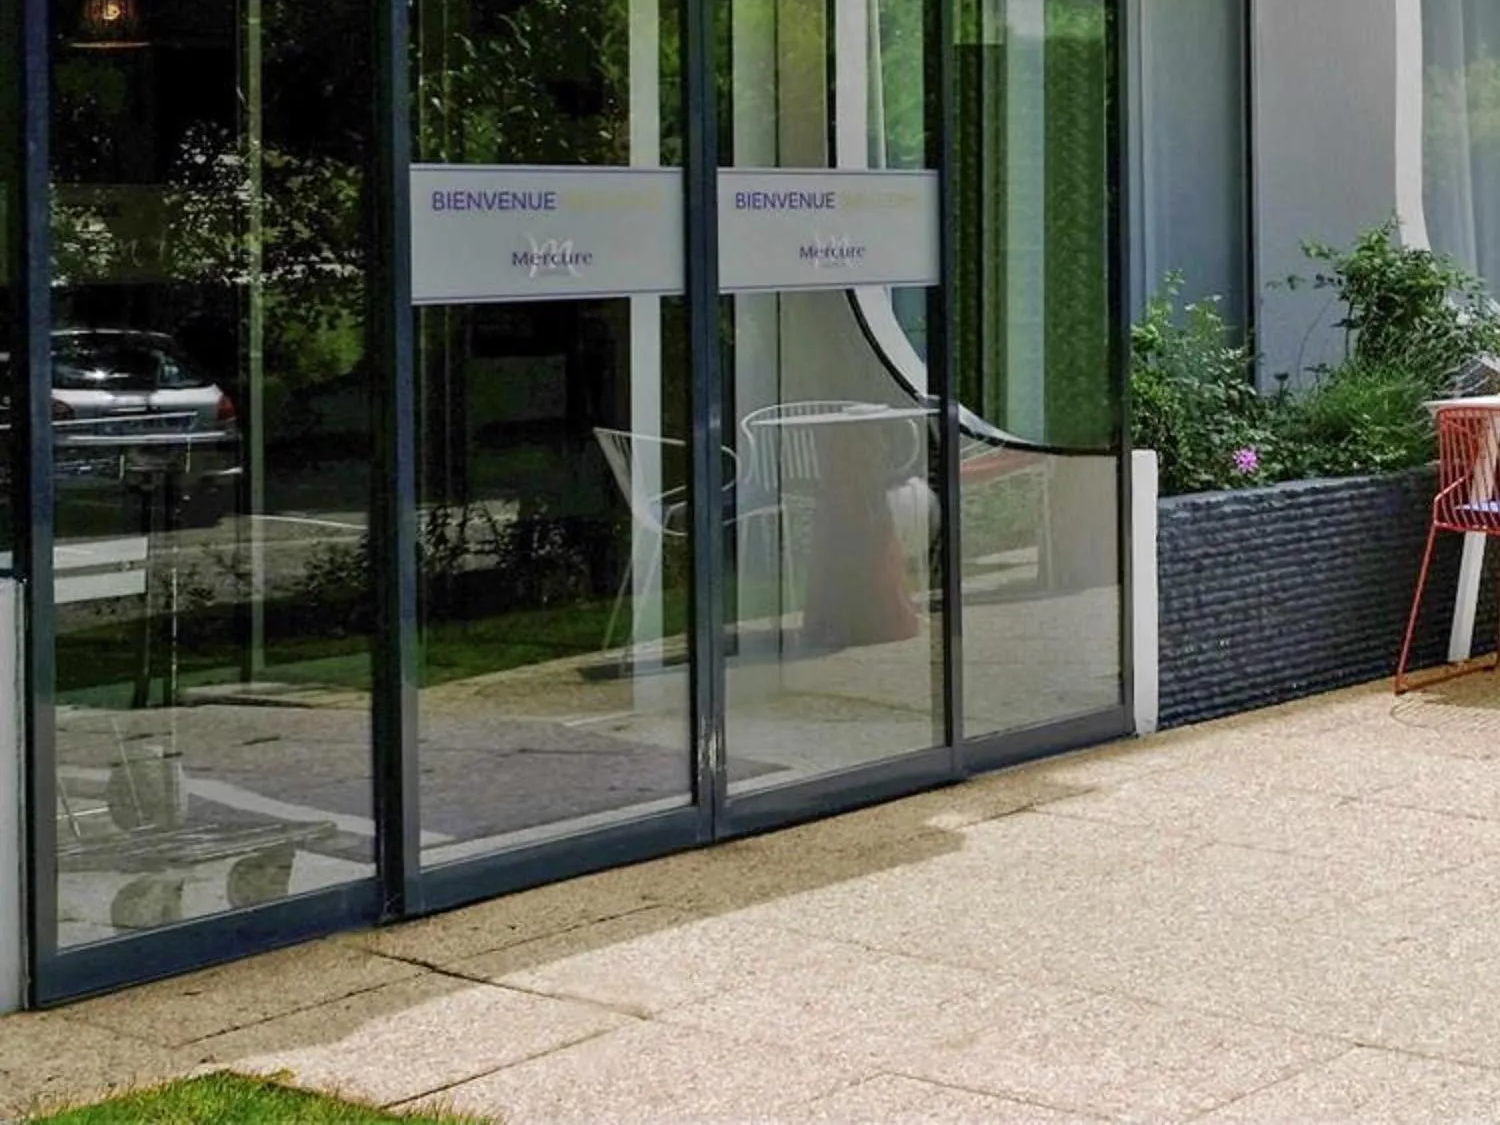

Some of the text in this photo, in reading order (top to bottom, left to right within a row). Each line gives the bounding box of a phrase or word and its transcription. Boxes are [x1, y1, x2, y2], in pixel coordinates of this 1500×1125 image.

[431, 190, 557, 212] BIENVENUE
[735, 191, 837, 211] BIENVENUE
[511, 250, 593, 267] Mercure
[799, 245, 866, 260] Mercure
